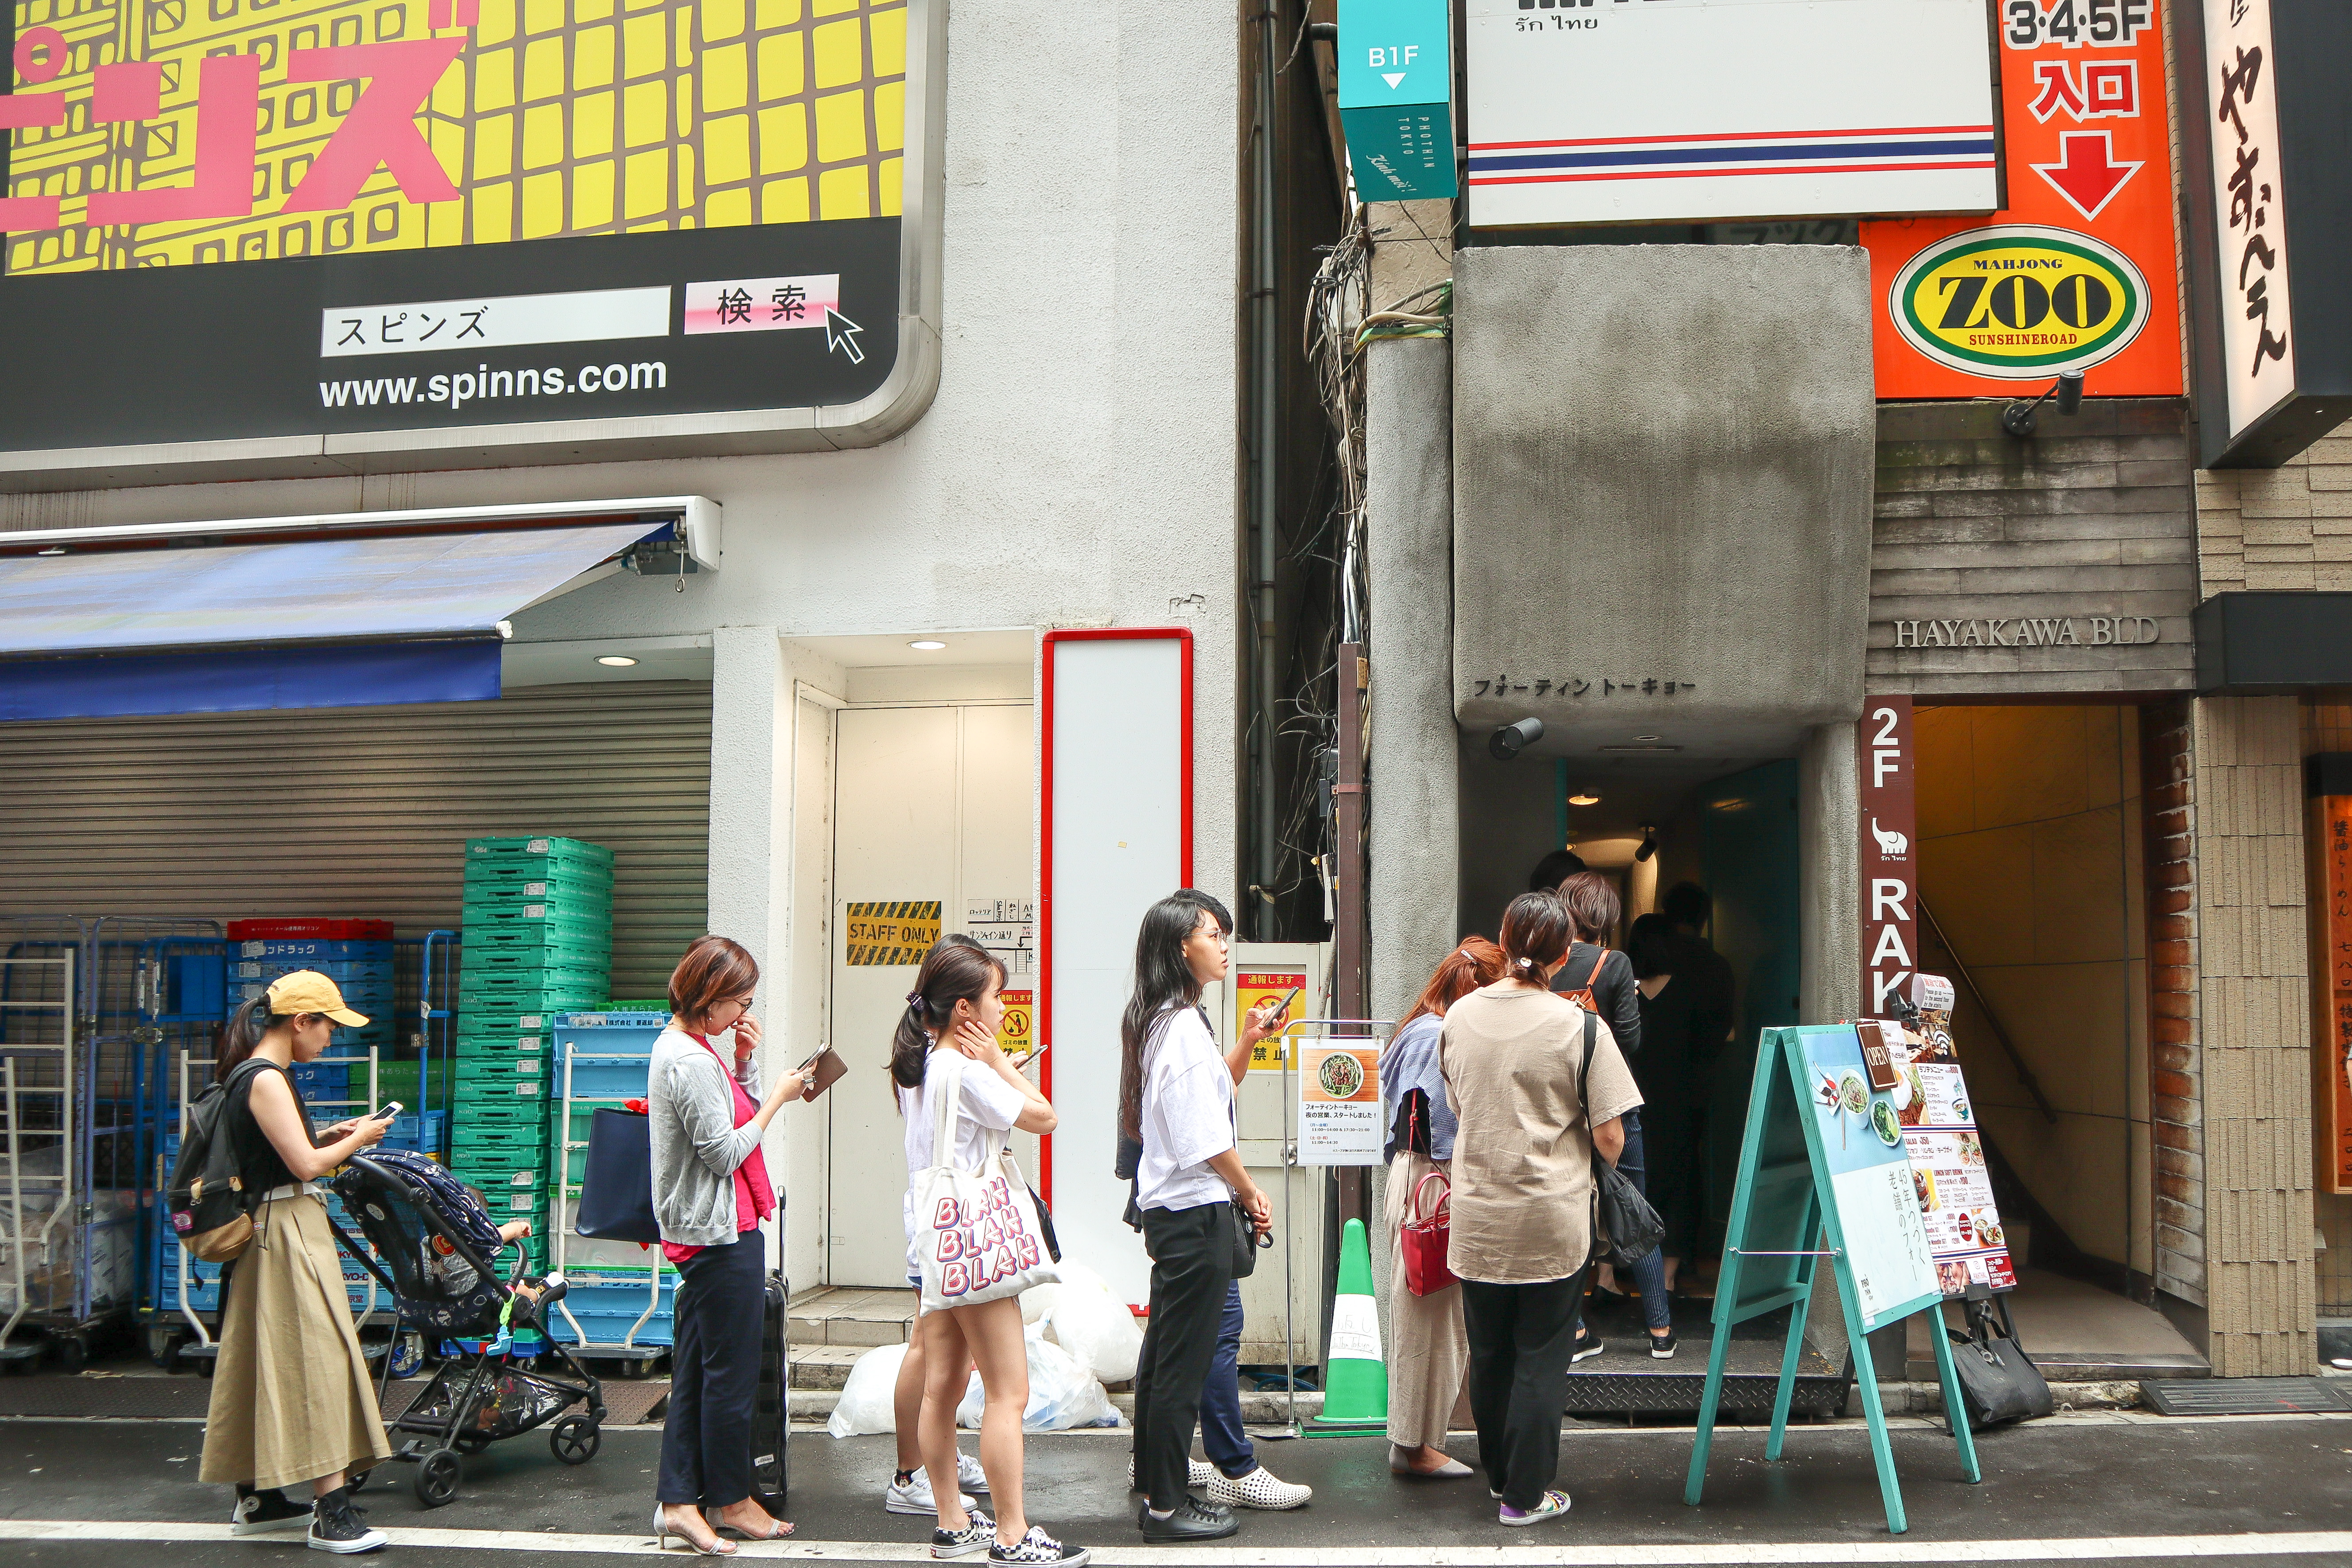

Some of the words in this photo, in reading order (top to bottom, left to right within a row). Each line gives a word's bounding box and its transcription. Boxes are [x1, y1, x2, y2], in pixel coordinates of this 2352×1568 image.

[1551, 15, 1598, 30] ไทย
[1369, 45, 1419, 67] B1F
[2033, 63, 2137, 119] 入口
[1398, 117, 1414, 154] TOKYO
[1418, 116, 1435, 168] PHOTHIN
[1973, 259, 2063, 270] MAHJONG
[717, 284, 807, 326] 検索
[1938, 274, 2111, 329] ZOO
[337, 305, 489, 346] スピンズ
[1969, 333, 2077, 345] SUNSHINEROAD
[319, 359, 667, 409] www.spinns.com
[1894, 618, 2081, 648] HAYAKAWA
[2090, 617, 2160, 644] BLD
[1872, 707, 1901, 788] 2F
[850, 924, 897, 941] STAFF
[901, 926, 939, 944] ONLY
[970, 931, 1012, 939] サンシャイン通り
[1247, 975, 1294, 985] 通報します
[1867, 1046, 1889, 1066] OPEN
[933, 1176, 1010, 1229] BLAH
[936, 1205, 1024, 1263] BLAH
[941, 1234, 1040, 1297] BLAH
